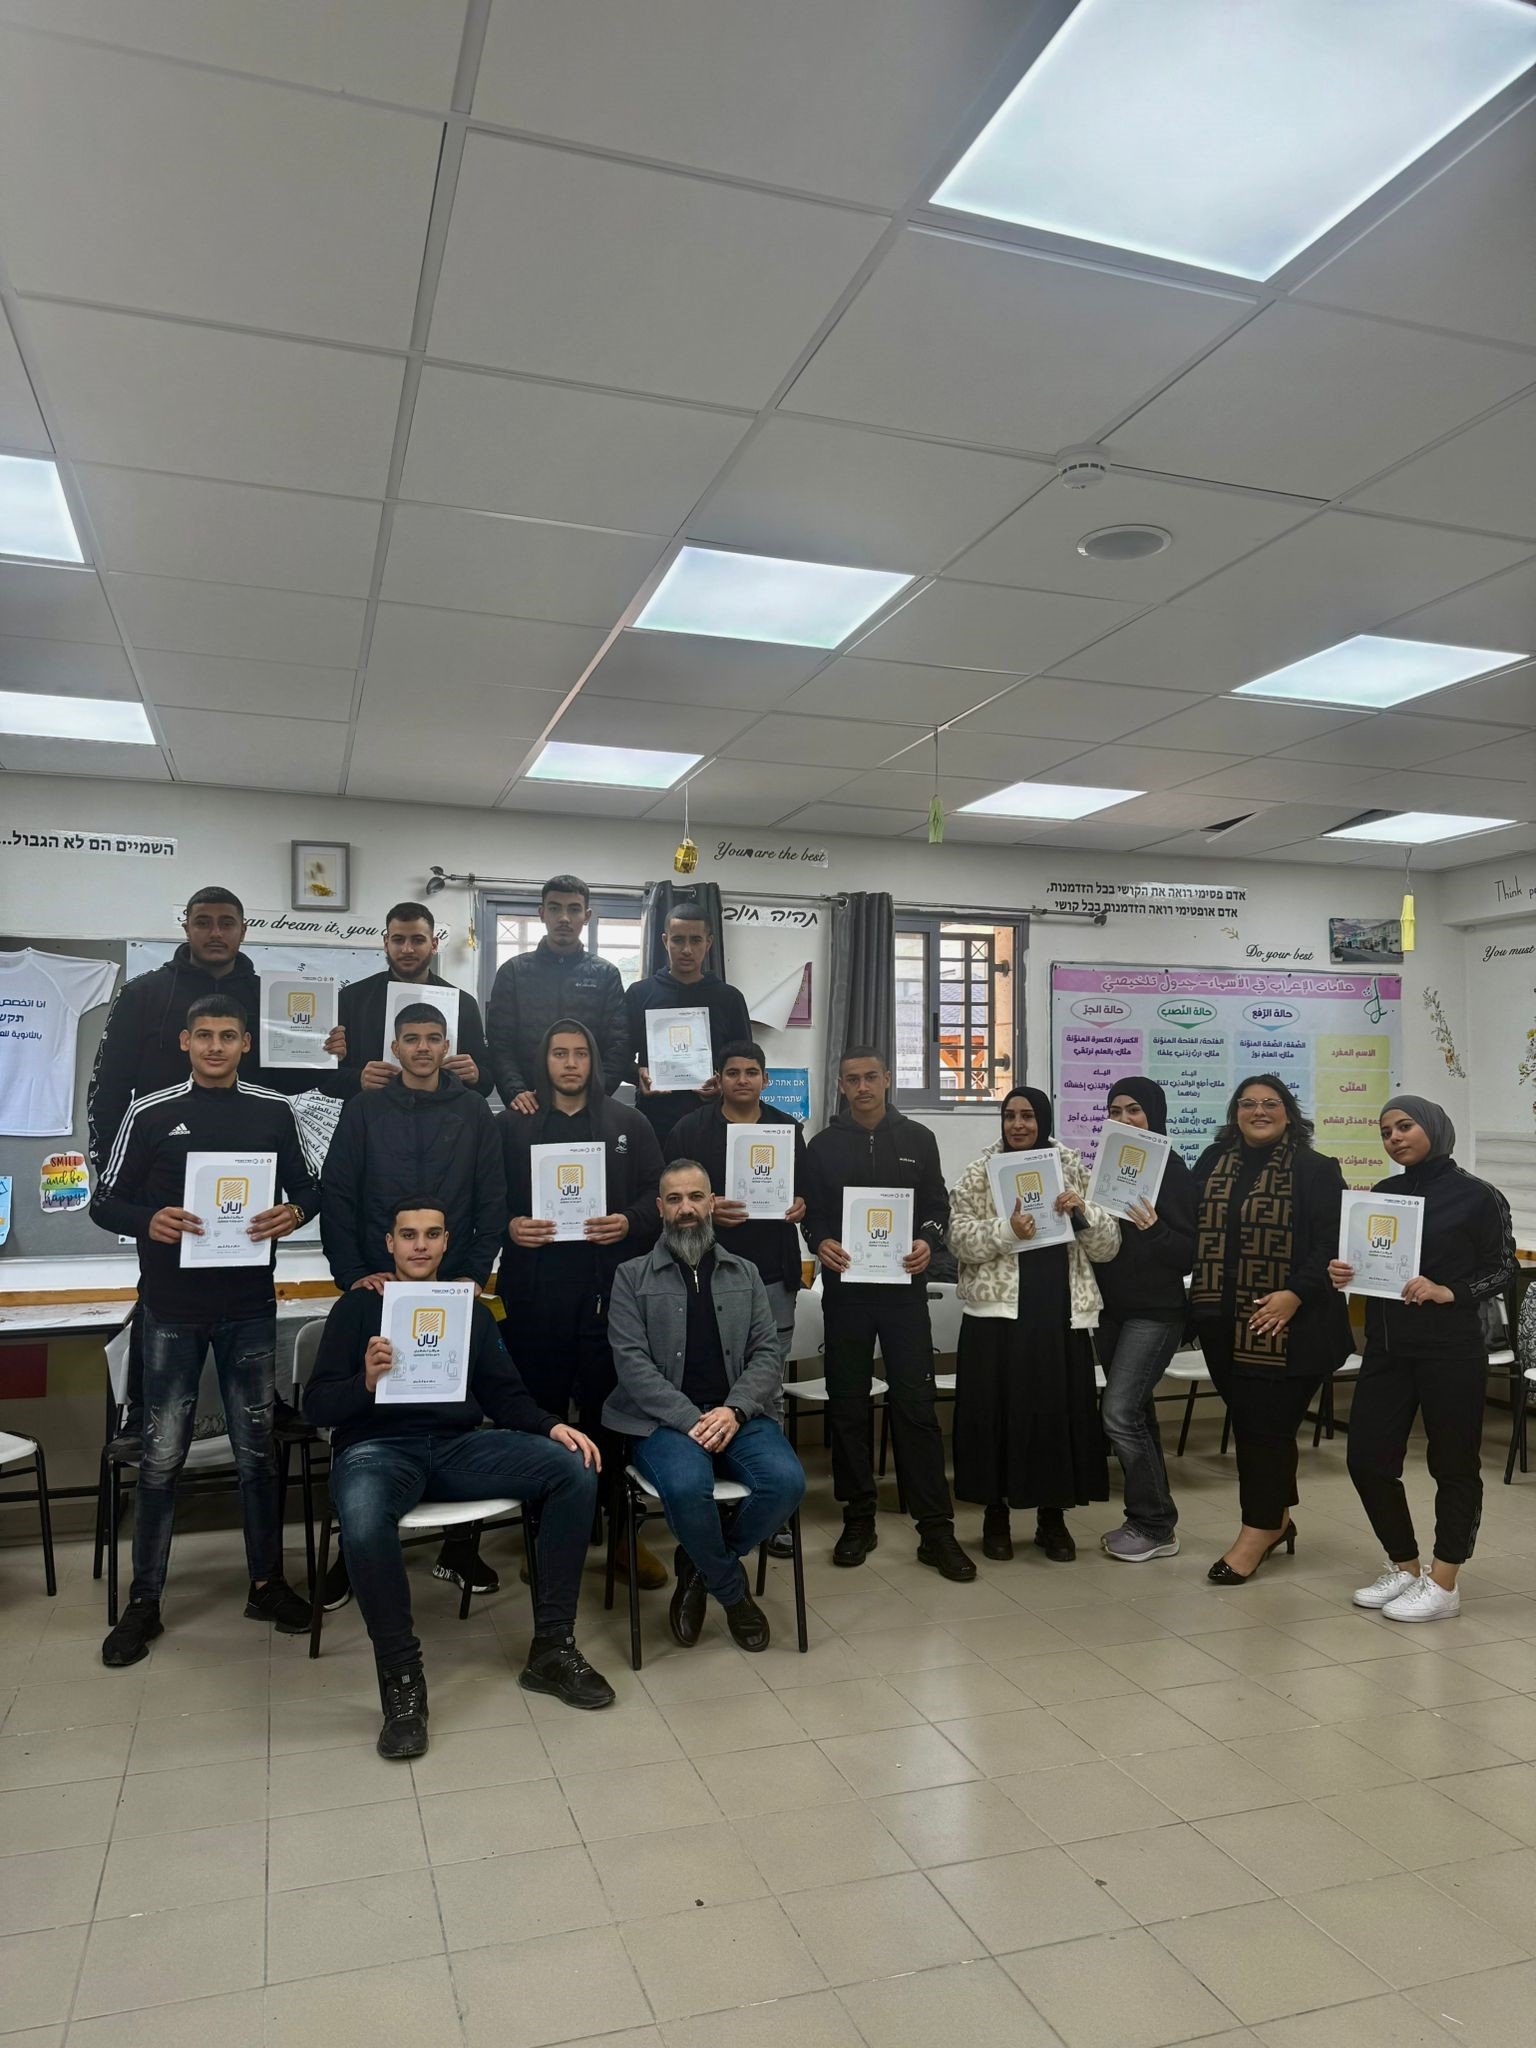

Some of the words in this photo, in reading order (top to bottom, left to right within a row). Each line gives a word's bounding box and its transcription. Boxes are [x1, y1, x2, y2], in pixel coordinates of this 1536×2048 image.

[64, 834, 85, 849] לא
[89, 838, 111, 851] הם
[116, 839, 174, 855] השמיים
[754, 849, 776, 859] are
[778, 846, 798, 860] the
[801, 848, 825, 862] best
[1095, 882, 1115, 895] בכל
[1117, 886, 1148, 897] הקושי
[1151, 888, 1166, 897] את
[1168, 888, 1192, 898] רואה
[1495, 875, 1523, 902] Think
[1195, 889, 1223, 900] פסימי
[1226, 890, 1246, 900] אדם
[1055, 901, 1079, 912] קושי
[1082, 899, 1101, 911] בכל
[1148, 905, 1173, 915] רואה
[723, 905, 759, 922] חיוב
[1175, 906, 1215, 918] אופטימי
[1218, 909, 1238, 918] אדם
[770, 910, 818, 928] תהיה
[243, 917, 267, 928] an
[270, 914, 327, 932] dream
[340, 925, 379, 939] you
[1245, 943, 1262, 958] Do
[1262, 950, 1291, 962] your
[1293, 947, 1314, 961] best
[1483, 946, 1509, 962] You
[1509, 945, 1535, 956] must
[1160, 974, 1197, 992] جدول
[1252, 978, 1267, 994] في
[1271, 979, 1313, 995] الإعراب
[1316, 978, 1355, 992] علامات
[1104, 1003, 1124, 1014] حالة
[1193, 1005, 1213, 1016] حالة
[1274, 1007, 1293, 1018] حالة
[0, 1014, 24, 1023] תקש
[12, 1030, 42, 1040] بالثانوية
[1331, 1049, 1354, 1058] المفرد
[1355, 1049, 1376, 1058] الاسم
[775, 1079, 792, 1087] אתה
[794, 1079, 805, 1087] אם
[50, 1156, 78, 1167] SMILE
[1368, 1158, 1383, 1166] جمع
[47, 1171, 67, 1185] and
[70, 1168, 82, 1184] be
